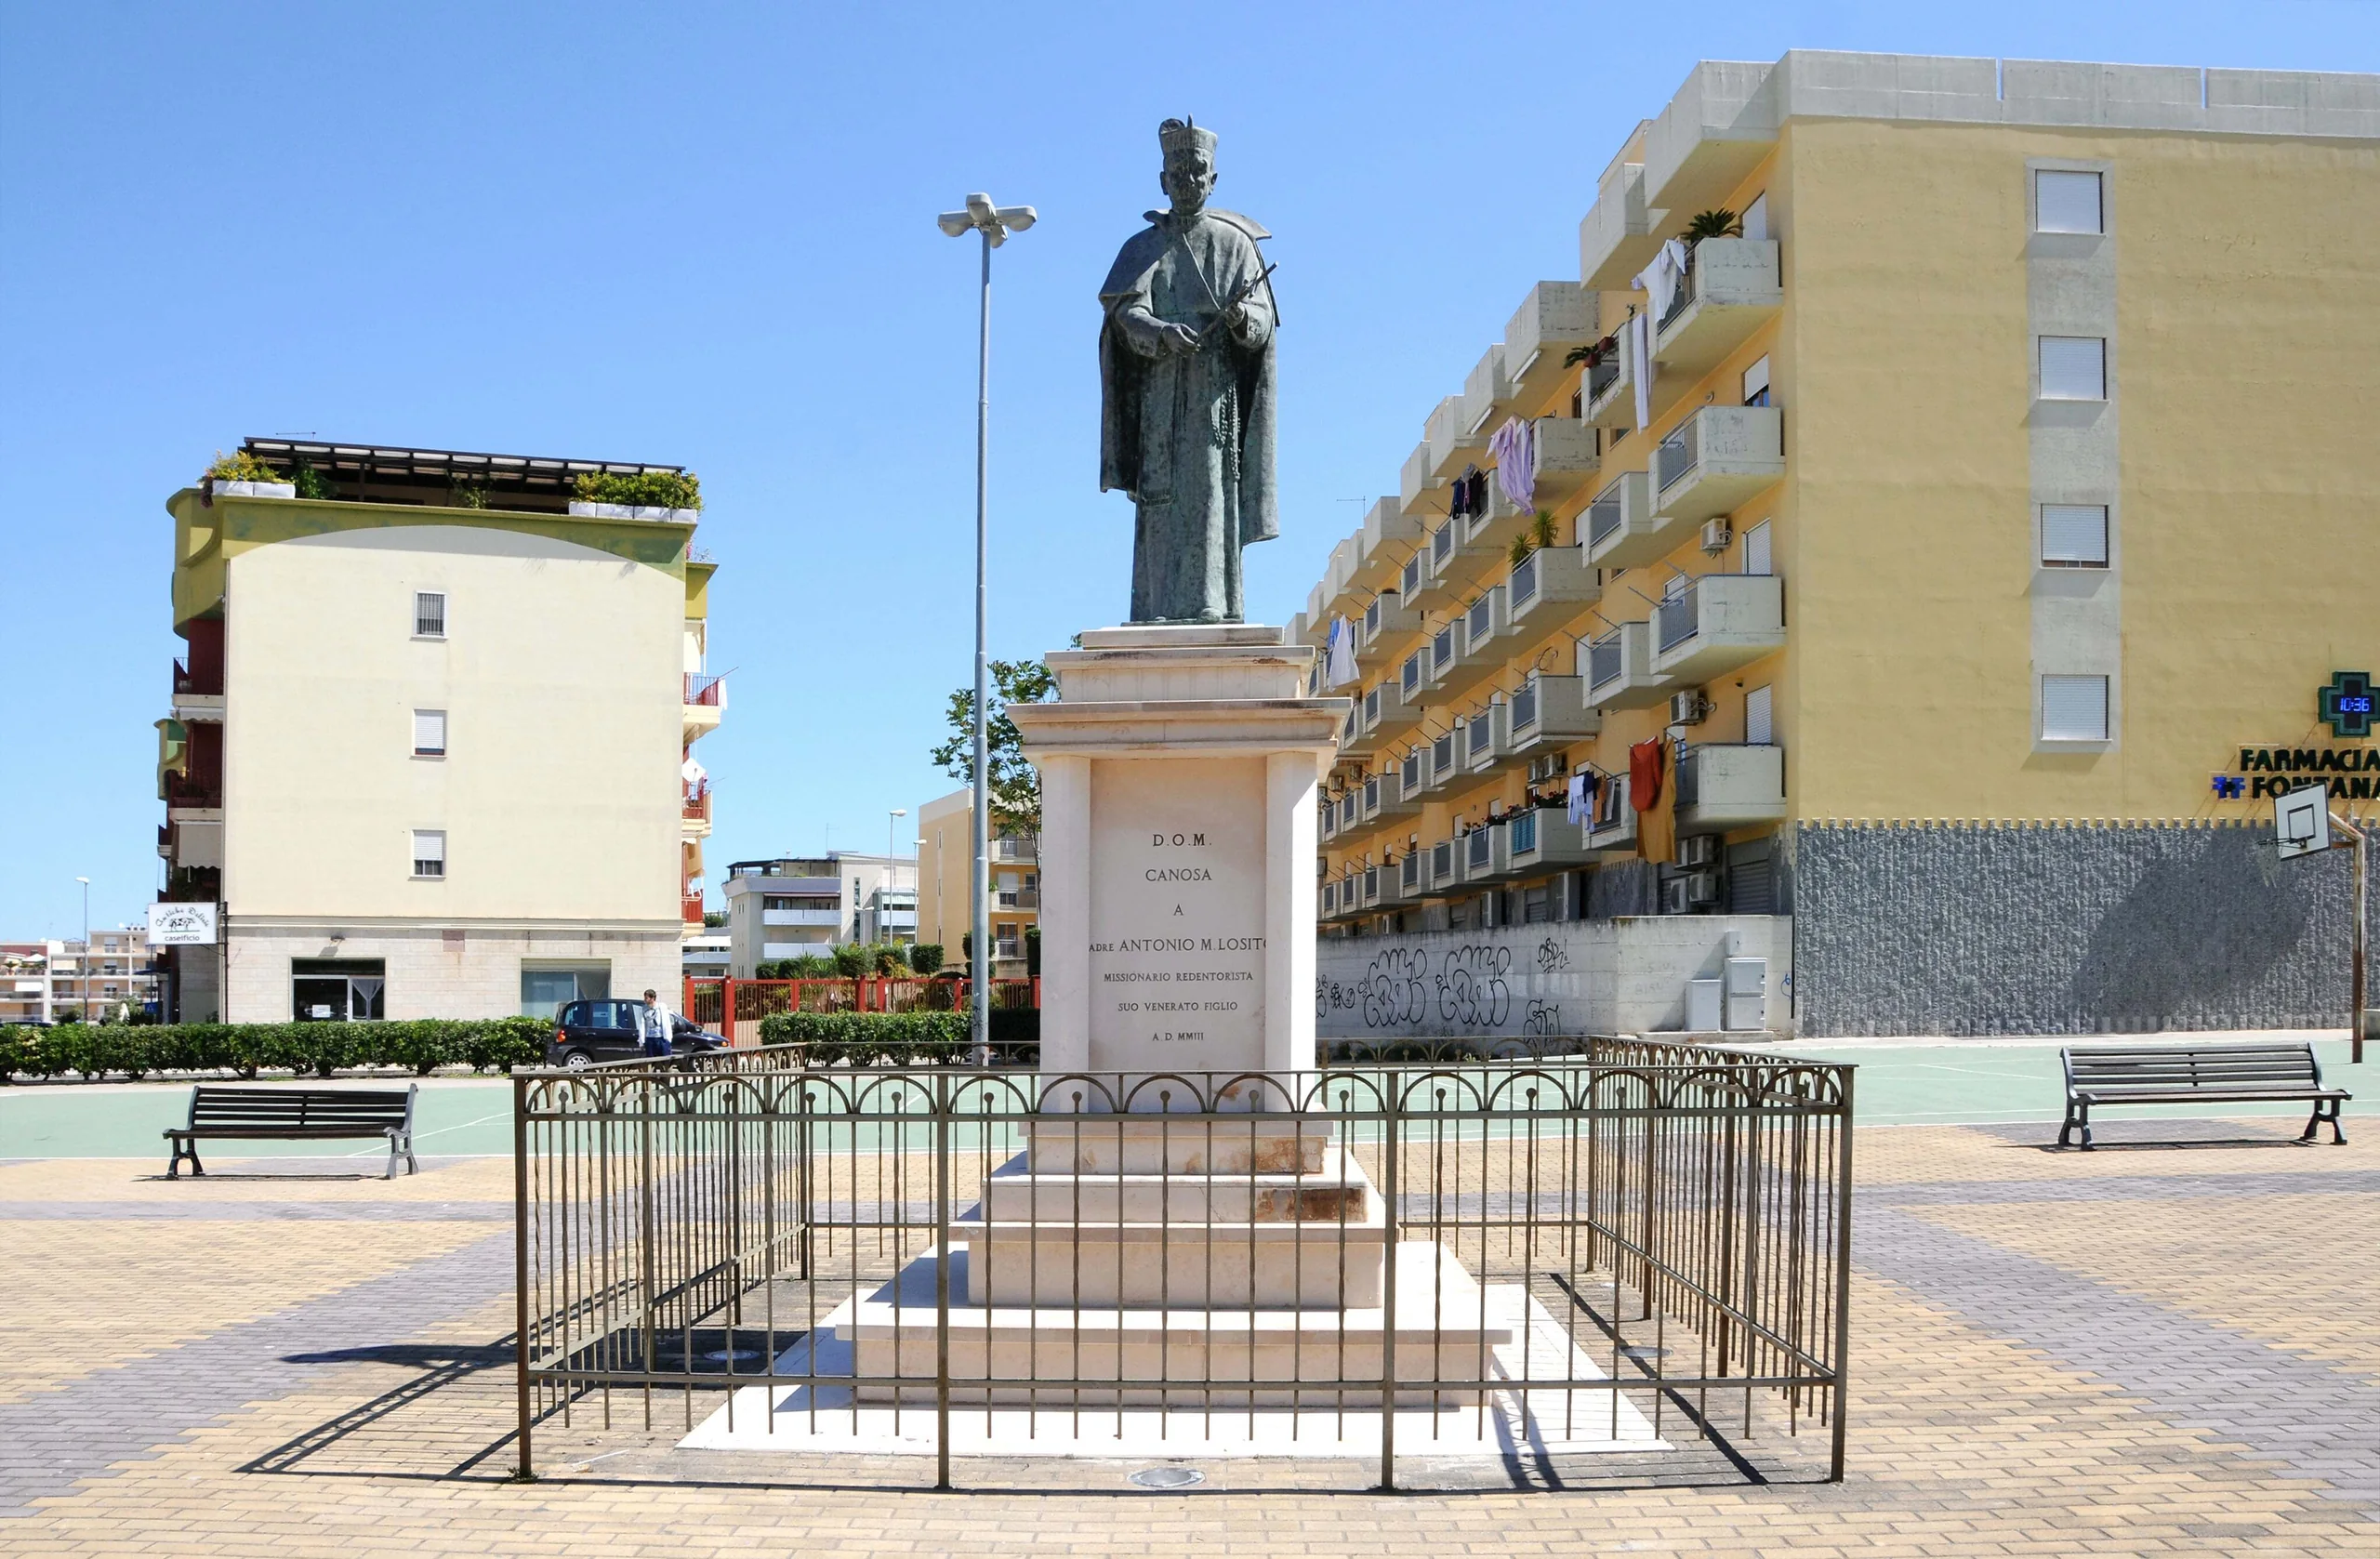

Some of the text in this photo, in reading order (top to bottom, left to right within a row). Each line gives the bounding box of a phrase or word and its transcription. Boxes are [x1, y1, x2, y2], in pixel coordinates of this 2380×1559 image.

[2340, 697, 2370, 712] 10:36
[2241, 748, 2380, 773] FARMACIA
[2252, 775, 2380, 799] FOAN
[1145, 868, 1212, 882] CANOSA
[1173, 904, 1184, 916] A
[1089, 943, 1115, 953] ADRE
[1119, 939, 1195, 952] ANTONIO
[1104, 971, 1254, 983] MISSIONARIO REDENTORISTA
[1117, 1001, 1238, 1011] SUO VENERATO FIGLIO
[1177, 1032, 1204, 1041] MMIII
